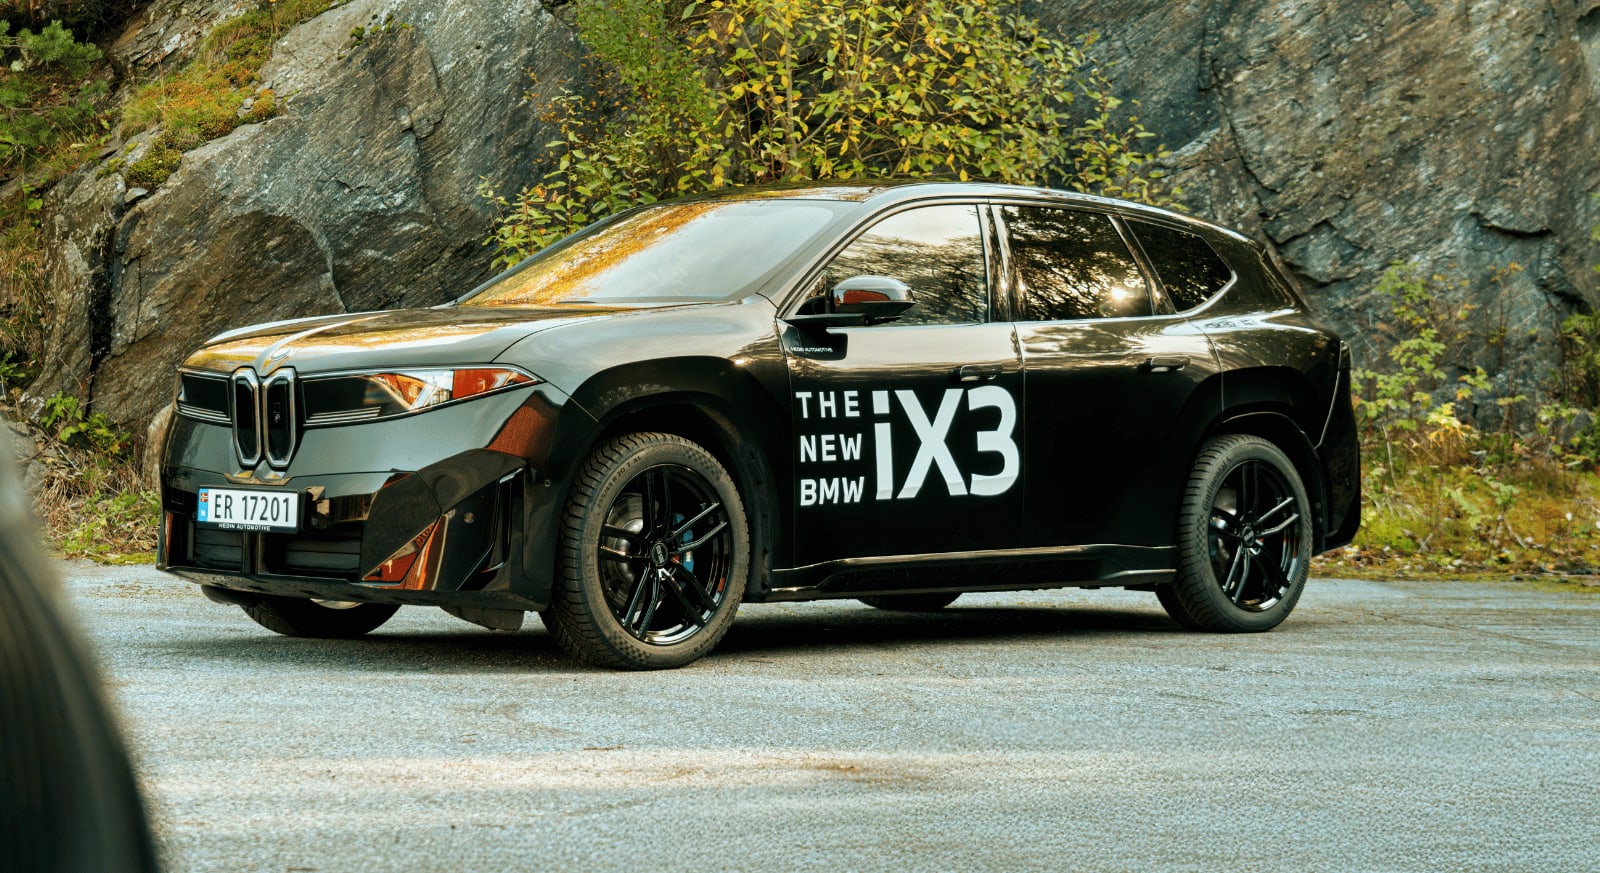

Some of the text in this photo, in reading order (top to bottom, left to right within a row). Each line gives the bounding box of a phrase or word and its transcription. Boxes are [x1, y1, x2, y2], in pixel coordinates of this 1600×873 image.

[795, 390, 861, 419] THE
[800, 433, 862, 463] NEW
[872, 385, 1020, 500] iX3
[800, 476, 865, 506] BMW
[214, 494, 289, 522] ER 17201
[236, 523, 271, 532] AUTOMOTIVE
